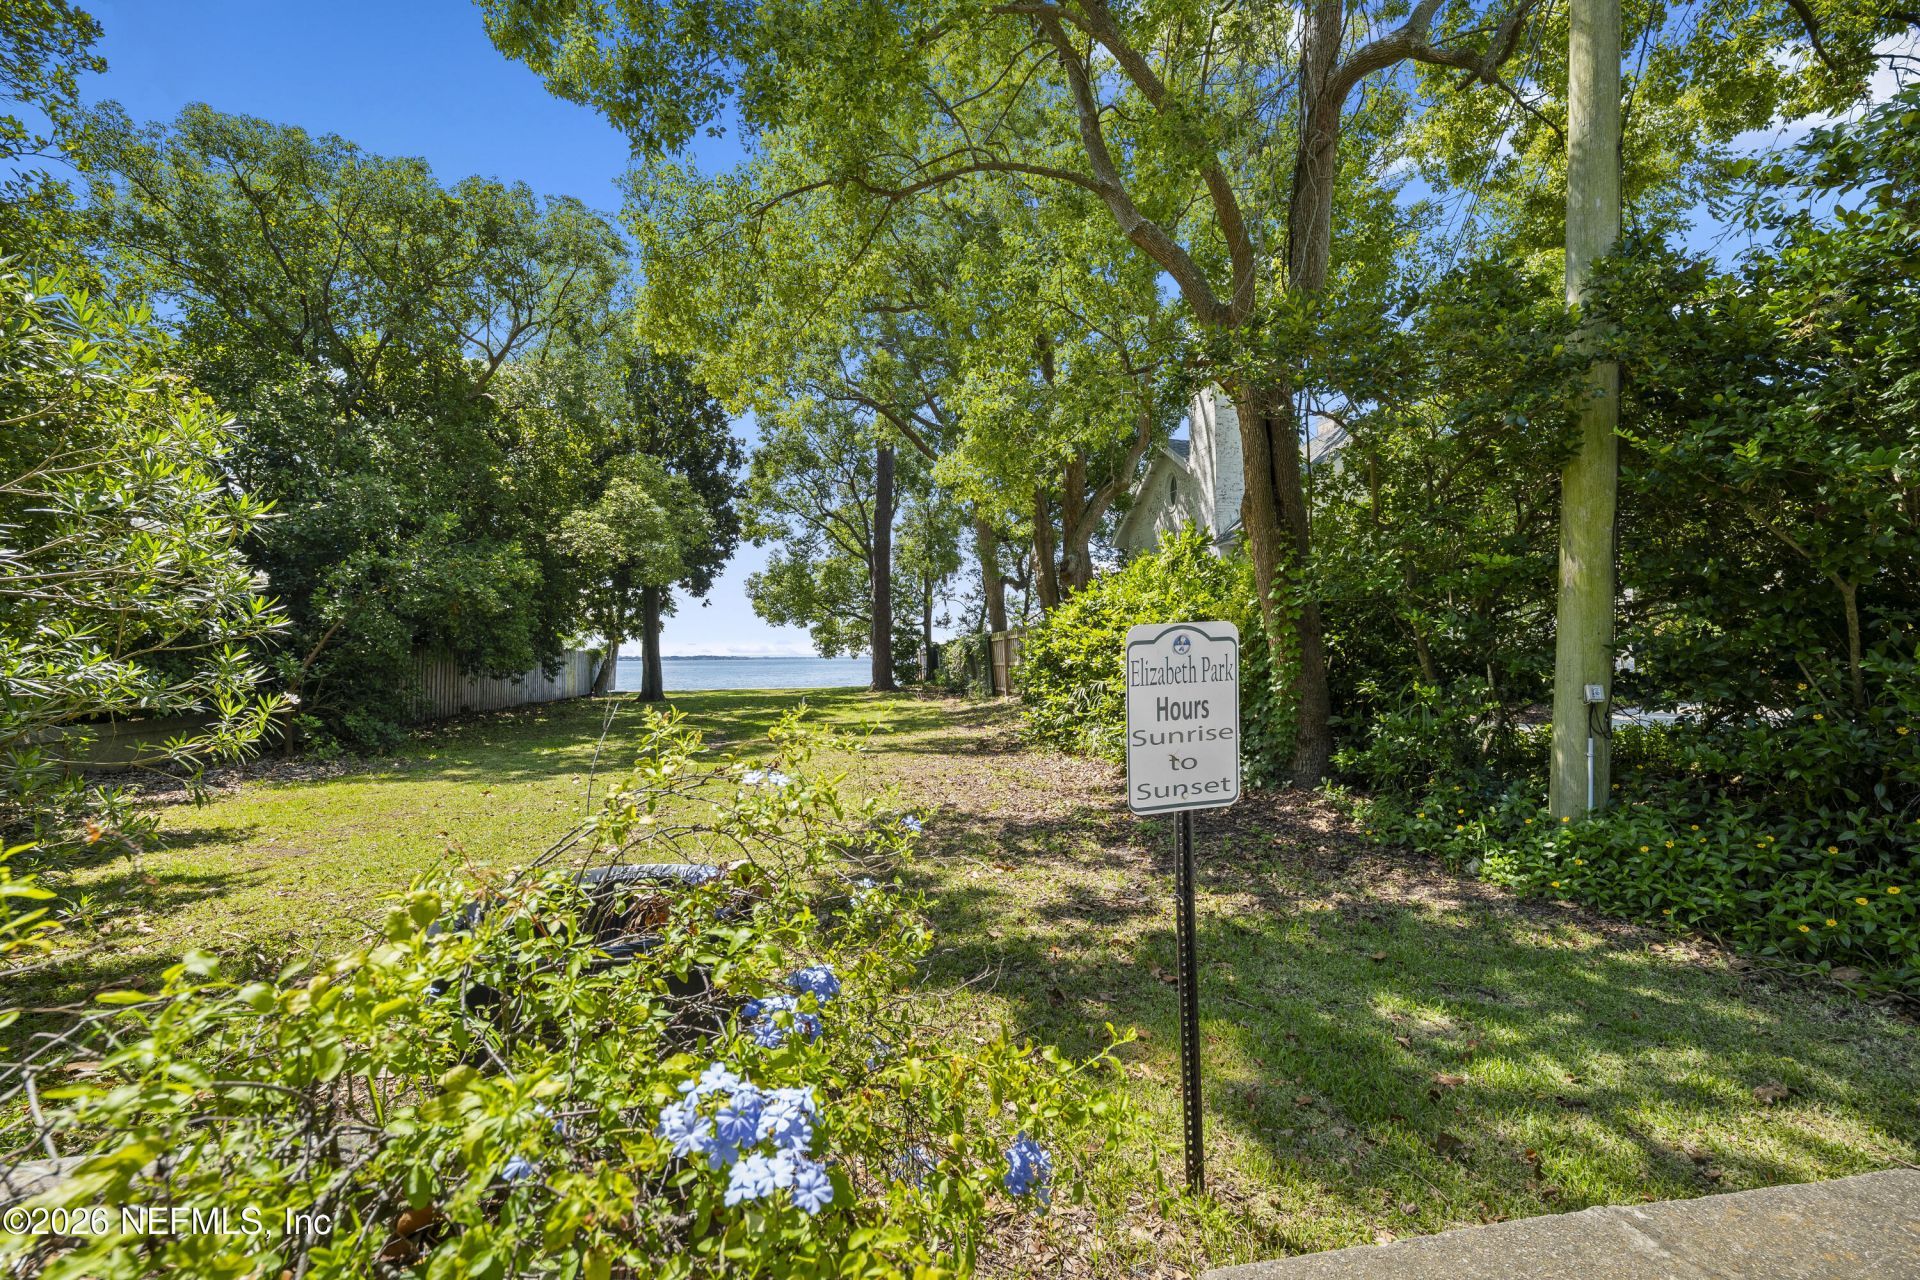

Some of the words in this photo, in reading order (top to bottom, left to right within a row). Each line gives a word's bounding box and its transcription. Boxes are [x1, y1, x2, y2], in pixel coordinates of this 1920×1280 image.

[1131, 655, 1197, 687] Elizabeth
[1201, 653, 1234, 683] Park
[1156, 696, 1210, 722] Hours
[1132, 725, 1234, 747] Sunrise
[1169, 753, 1198, 771] to
[1137, 777, 1231, 800] Sunset
